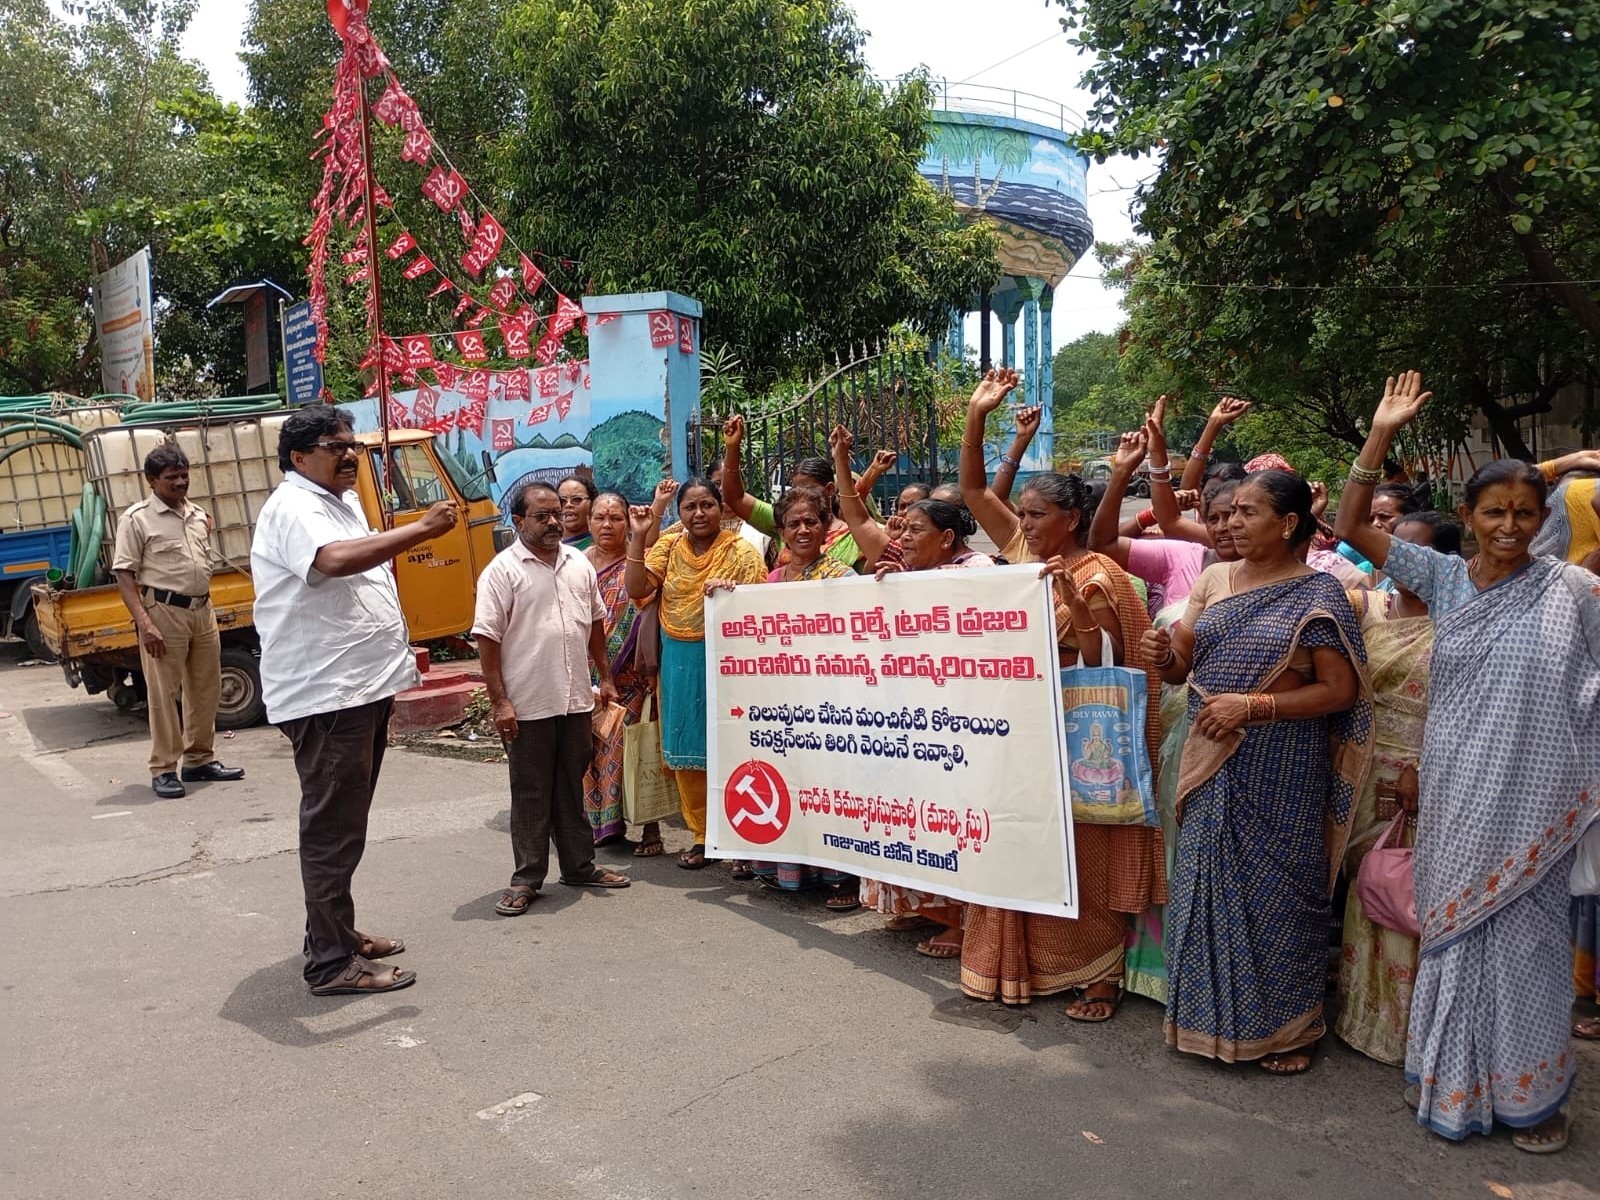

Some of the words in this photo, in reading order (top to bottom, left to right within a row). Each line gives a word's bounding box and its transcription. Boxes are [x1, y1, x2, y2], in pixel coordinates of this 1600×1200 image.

[435, 193, 451, 209] CITU
[474, 238, 494, 254] CITU
[491, 292, 507, 308] CITU
[652, 334, 674, 343] CITU
[416, 405, 434, 418] CITU
[408, 552, 433, 563] ape
[721, 613, 846, 646] అక్కిరెడ్డిపాలెం
[849, 606, 891, 641] రైల్వే
[894, 606, 951, 636] ట్రాక్
[956, 607, 1028, 636] ప్రజల
[719, 653, 811, 676] మంచినీరు
[814, 654, 878, 685] సమస్య
[880, 653, 1044, 687] పరిష్కరించాలి.
[748, 704, 816, 726] నిలుపుదల
[818, 702, 853, 725] చేసిన
[856, 706, 928, 731] మంచినీటి
[931, 706, 1010, 737] కోళాయిల
[824, 733, 858, 754] తిరిగి
[860, 734, 909, 759] వెంటనే
[798, 787, 831, 817] భారత
[822, 833, 881, 857] గాజువాక
[883, 841, 914, 864] జోన్
[916, 849, 960, 872] కమిటీ
